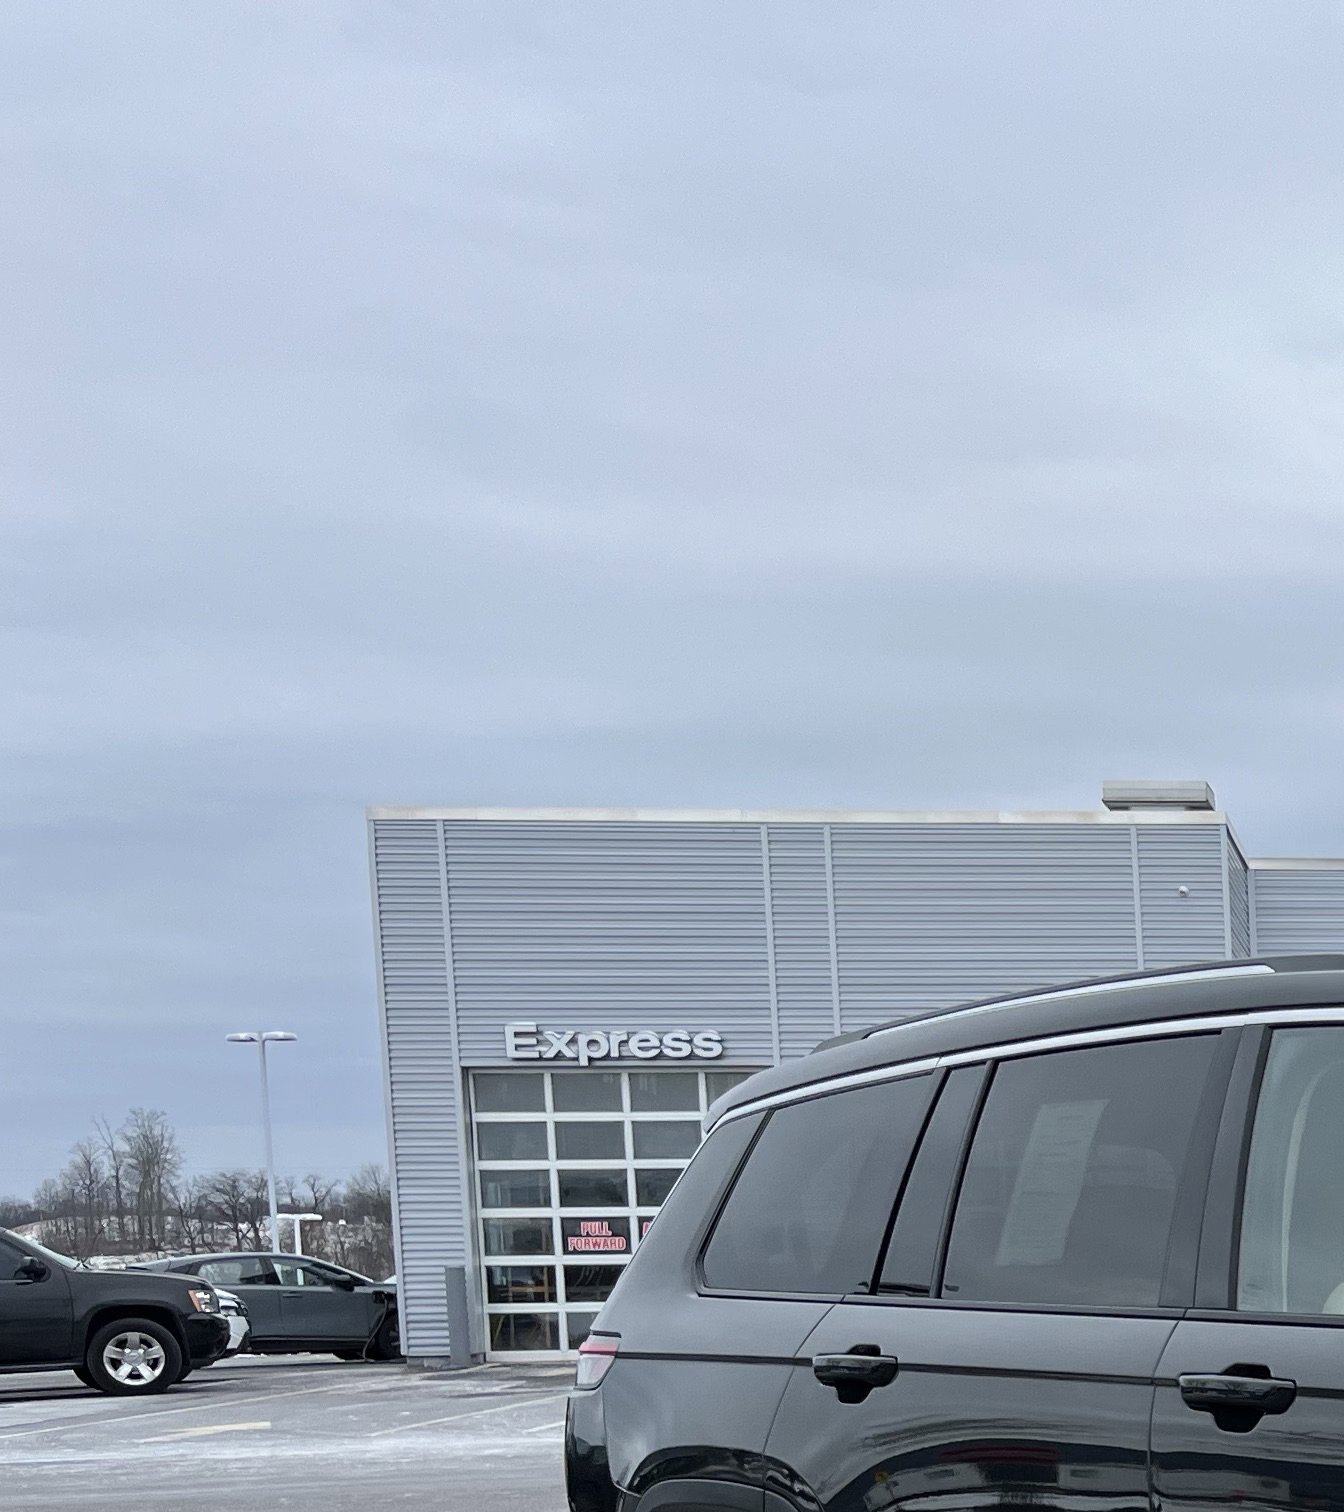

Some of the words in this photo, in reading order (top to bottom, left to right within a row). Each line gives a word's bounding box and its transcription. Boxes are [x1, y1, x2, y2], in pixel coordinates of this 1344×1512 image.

[504, 1021, 723, 1066] Express
[581, 1221, 612, 1236] PULL
[568, 1237, 626, 1251] FORWARD
